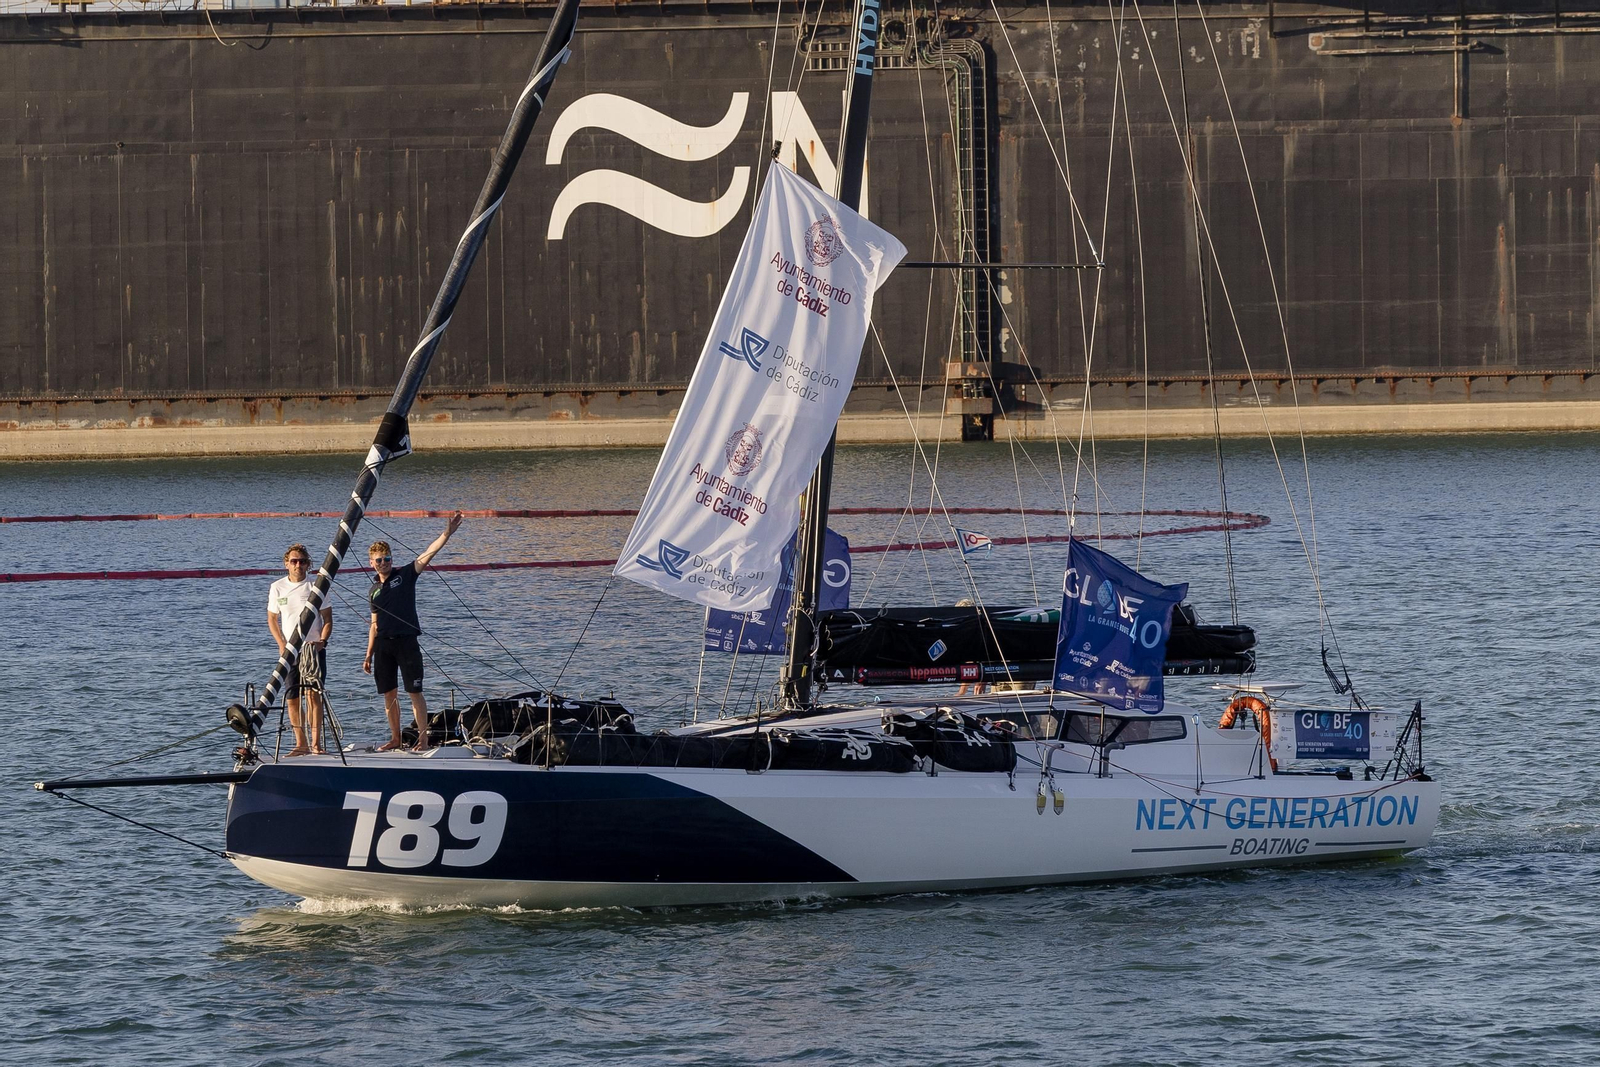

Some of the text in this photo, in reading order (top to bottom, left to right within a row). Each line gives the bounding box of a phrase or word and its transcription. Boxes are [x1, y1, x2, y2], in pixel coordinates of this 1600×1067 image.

[855, 0, 880, 76] HYD
[770, 251, 852, 305] Ayuntamiento
[776, 279, 830, 317] de Cádiz
[766, 366, 819, 402] de Cádiz
[772, 345, 840, 389] Diputación
[689, 462, 768, 515] Ayuntamiento
[695, 490, 750, 527] de Cádiz
[688, 573, 706, 585] de
[692, 554, 765, 582] Diputan
[909, 666, 957, 680] Lippmann
[1343, 723, 1363, 740] 40
[342, 790, 508, 868] 189
[1135, 795, 1420, 831] NEXT GENERATION
[1229, 838, 1310, 856] BOATING
